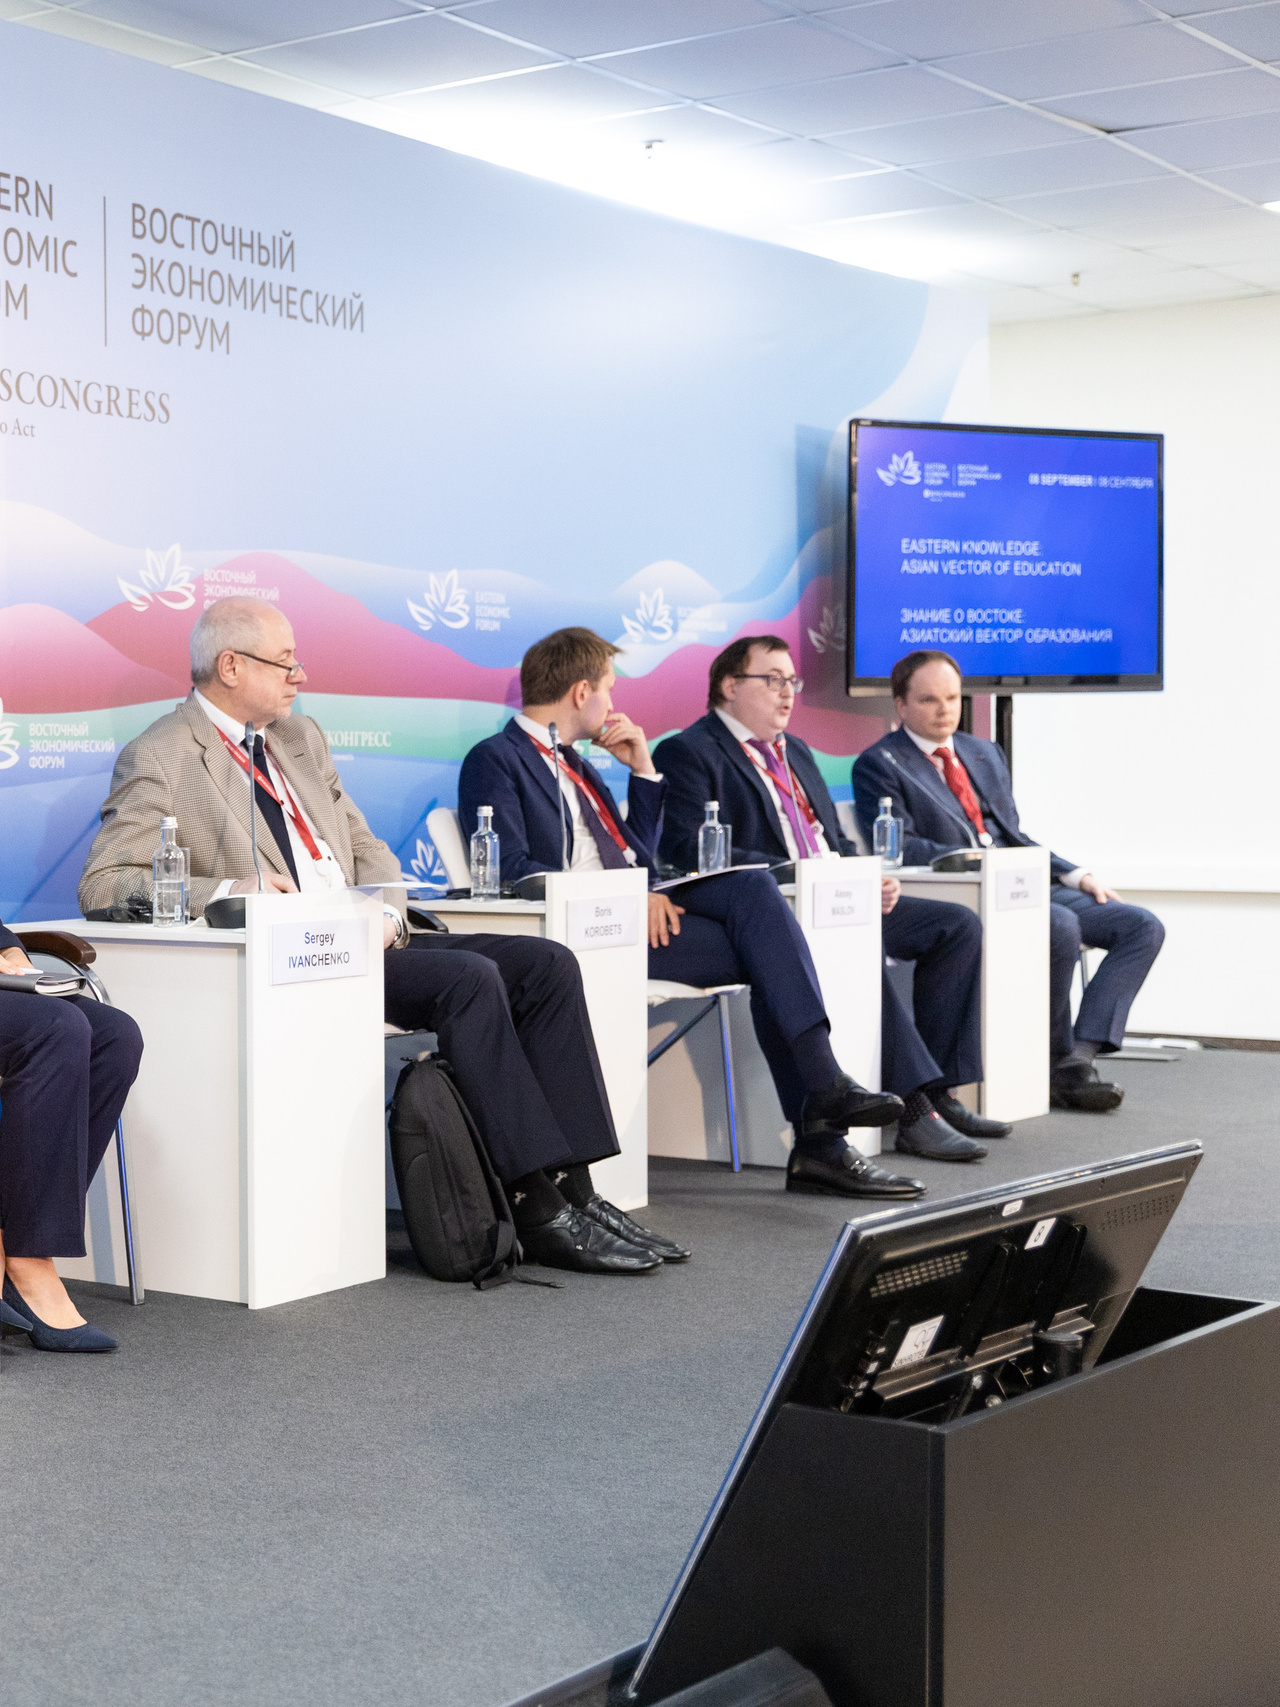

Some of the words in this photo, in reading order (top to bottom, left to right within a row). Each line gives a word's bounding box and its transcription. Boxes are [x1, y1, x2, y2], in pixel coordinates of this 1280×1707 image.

[131, 202, 296, 273] ВОСТОЧНЫЙ
[131, 253, 366, 334] ЭКОНОМИЧЕСКИЙ
[131, 304, 231, 355] ФОРУМ
[10, 417, 36, 439] Act
[900, 538, 960, 555] EASTERN
[900, 559, 939, 576] ASIAN
[941, 560, 993, 576] VECTOR
[993, 561, 1011, 576] OF
[1013, 561, 1082, 577] EDUCATION
[900, 608, 952, 624] ЗНАНИЕ
[975, 628, 1023, 644] ВЕКТОР
[29, 721, 89, 737] ВОСТОЧНЫЙ
[29, 738, 116, 753] ЭКОНОМИЧЕСКИЙ
[325, 730, 392, 748] КОНГРЕСС
[29, 755, 65, 769] ФОРУМ
[594, 905, 612, 918] Boris
[584, 923, 623, 939] KOROBETS
[303, 932, 336, 949] Sergey
[287, 950, 351, 970] IVANCHENKO
